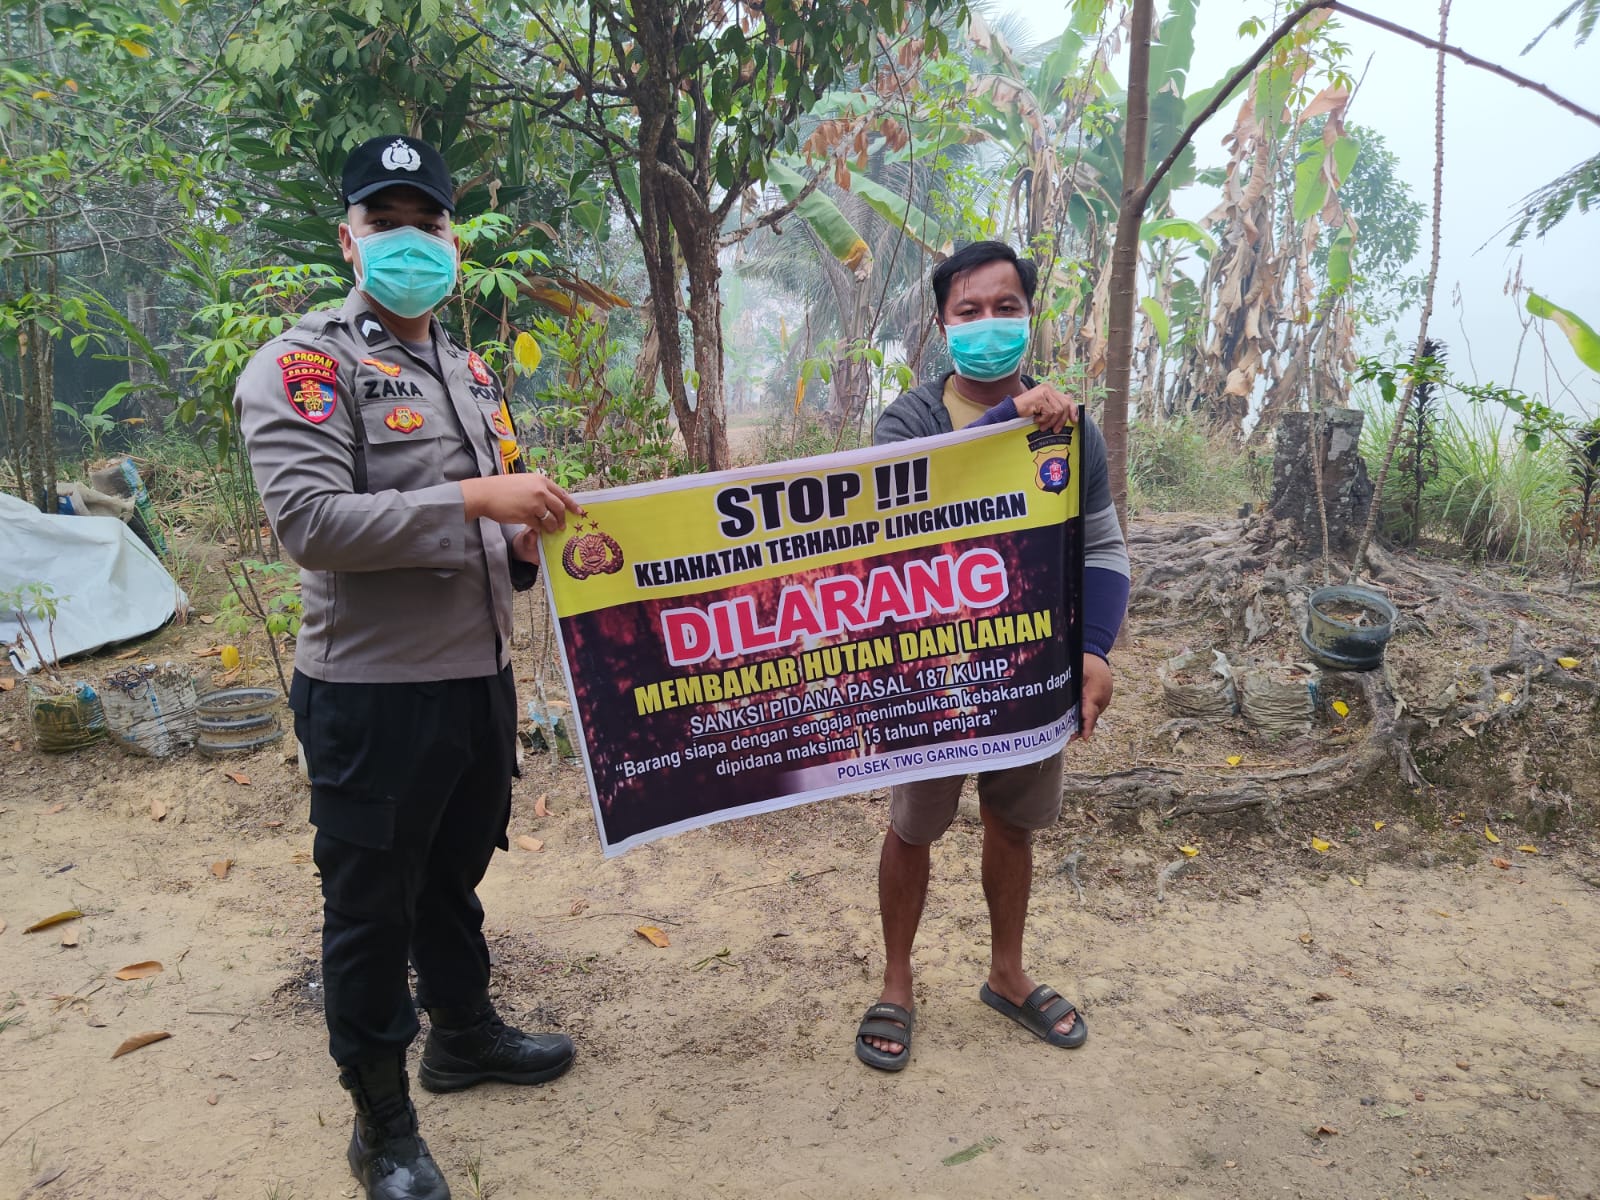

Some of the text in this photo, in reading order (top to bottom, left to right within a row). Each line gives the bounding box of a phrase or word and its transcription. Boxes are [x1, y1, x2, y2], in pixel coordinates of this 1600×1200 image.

[288, 367, 330, 377] PROPAM
[294, 352, 333, 369] PROPAM
[363, 379, 424, 399] ZAKA
[716, 456, 930, 539] STOP !!!
[633, 492, 1027, 588] KEJAHATAN TERHADAP LINGKUNGAN
[662, 549, 1008, 665] DILARANG
[633, 609, 1053, 716] MEMBAKAR HUTAN DAN LAHAN
[690, 658, 1008, 735] SANKSI PIDANA PASAL 187 KUHP
[615, 751, 681, 777] “Barang
[684, 740, 727, 761] siapa
[731, 728, 788, 751] dengan
[792, 713, 851, 737] sengaja
[855, 696, 960, 724] menimbulkan
[962, 682, 1043, 706] kebakaran
[716, 709, 998, 776] dipidana maksimal 15 tahun penjara”
[837, 758, 891, 779] POLSEK
[893, 752, 923, 770] TWG
[926, 744, 979, 765] GARING
[981, 740, 1010, 756] DAN
[1014, 730, 1053, 750] PULAU
